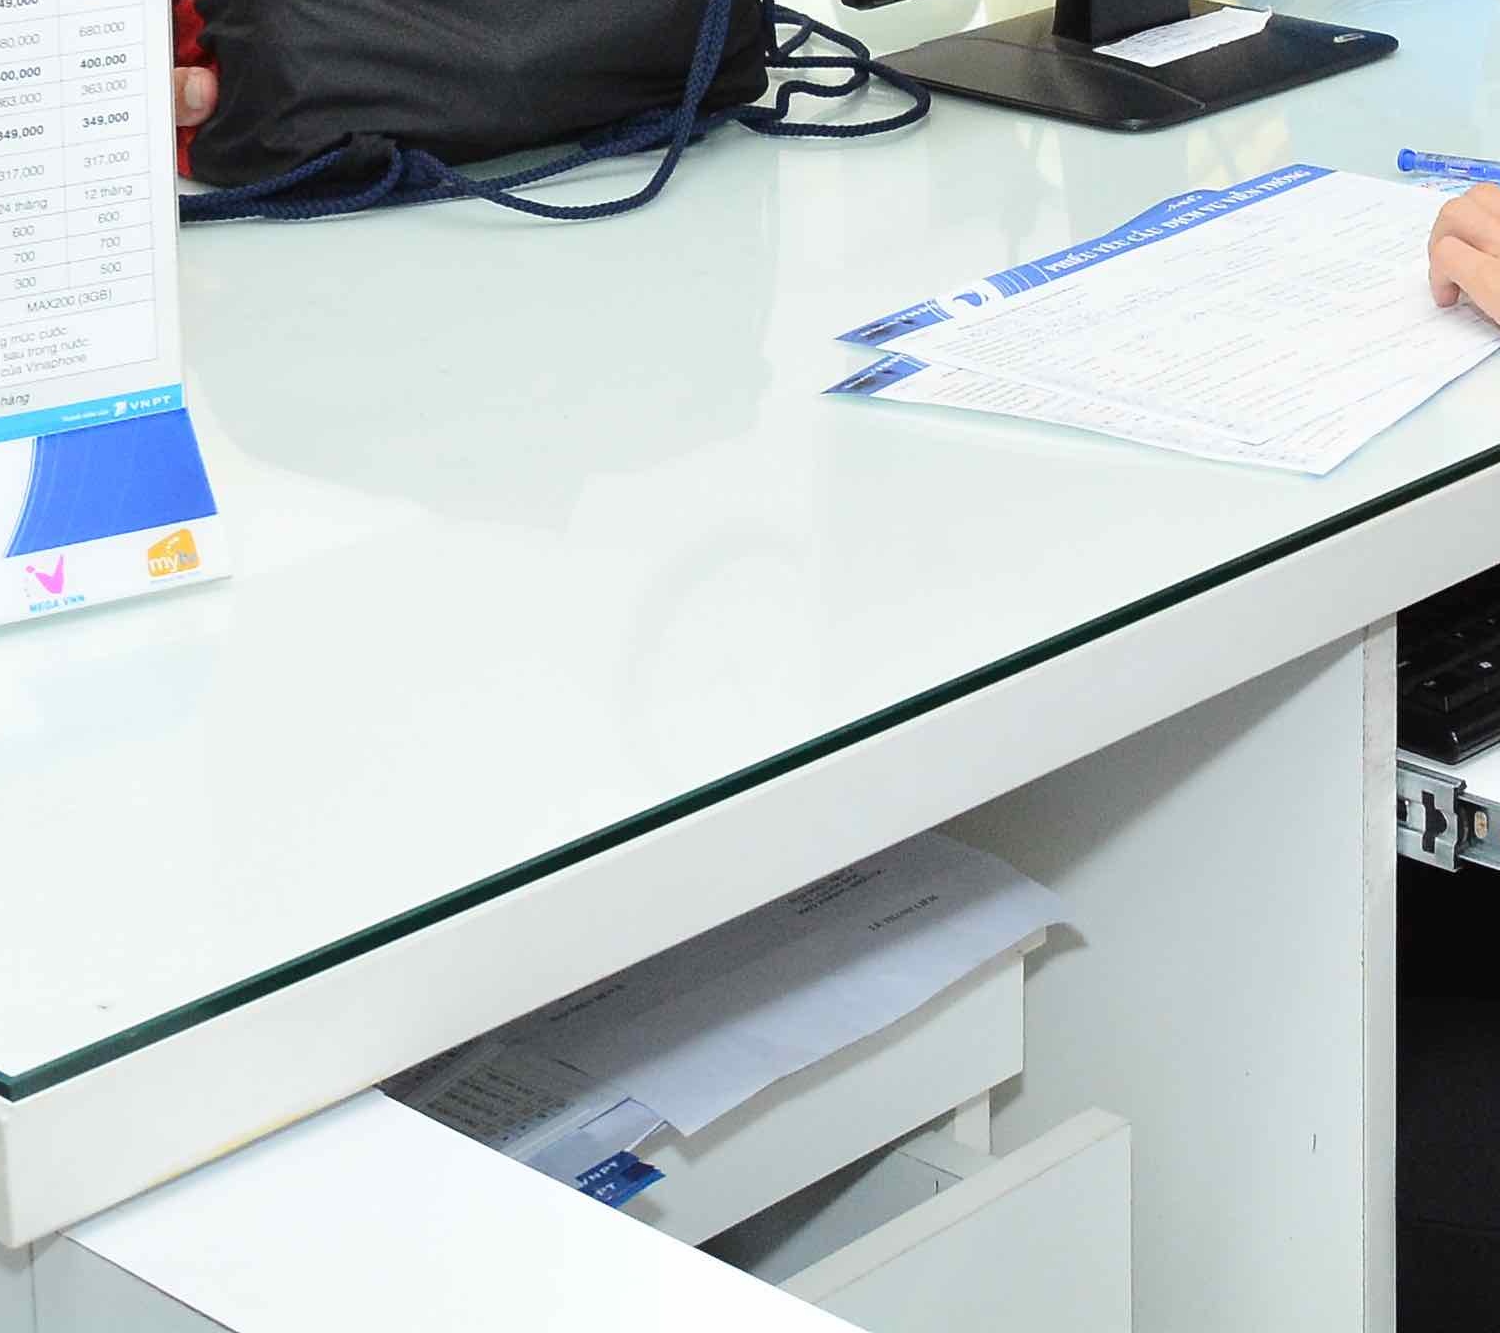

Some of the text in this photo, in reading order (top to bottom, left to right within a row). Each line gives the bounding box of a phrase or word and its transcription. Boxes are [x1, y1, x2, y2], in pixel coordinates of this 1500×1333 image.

[127, 393, 171, 410] VNPT
[29, 593, 86, 614] MEGA VNN
